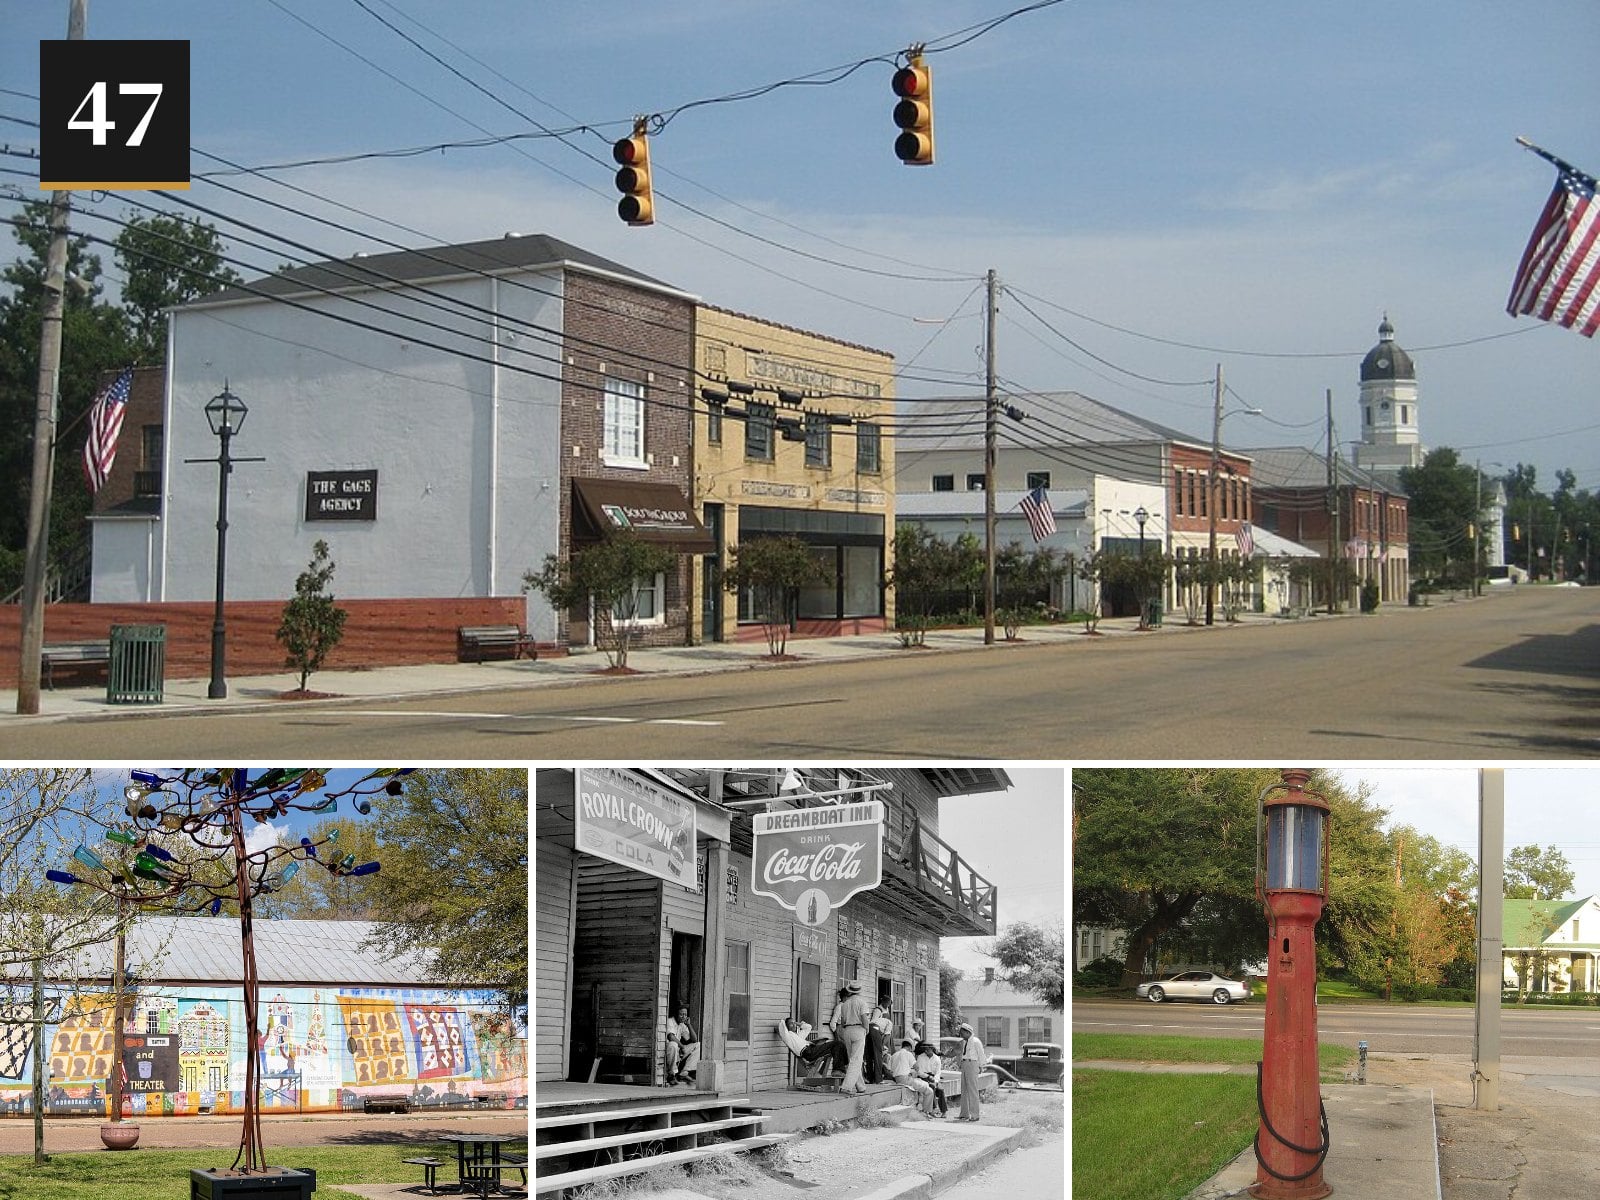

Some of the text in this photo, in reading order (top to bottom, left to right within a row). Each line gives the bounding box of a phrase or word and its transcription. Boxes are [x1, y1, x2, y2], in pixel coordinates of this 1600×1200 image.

[313, 480, 371, 494] THE GAGE
[319, 498, 363, 512] AGENCY
[581, 792, 628, 823] ROYAL
[628, 802, 674, 850] CROWN
[766, 805, 873, 831] DREAMBOAT INN
[800, 834, 831, 845] DRINK
[615, 840, 654, 866] COLA
[763, 841, 867, 884] Coca-Cola
[135, 1049, 154, 1060] and
[129, 1080, 166, 1091] THEATER
